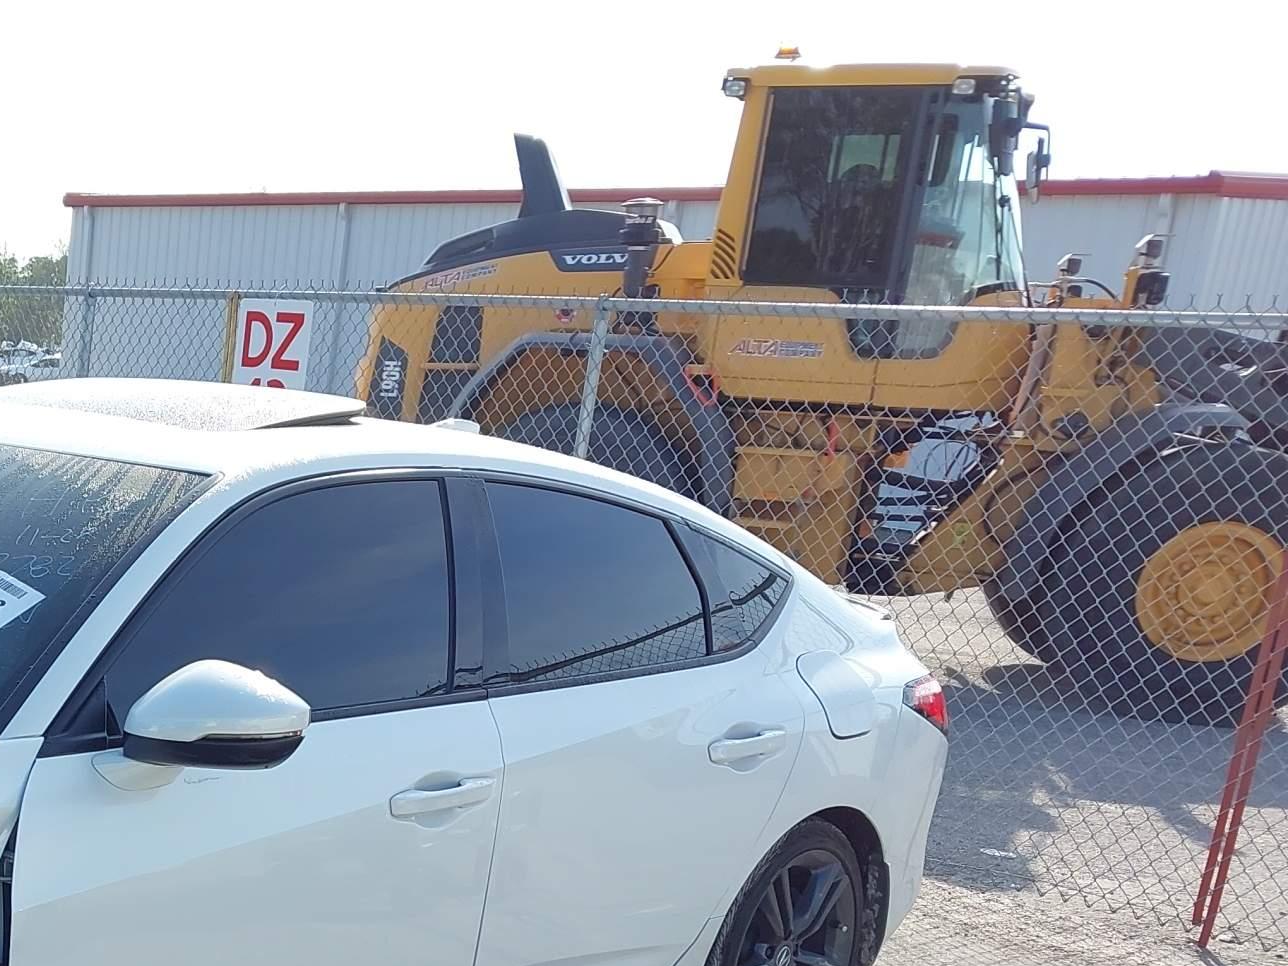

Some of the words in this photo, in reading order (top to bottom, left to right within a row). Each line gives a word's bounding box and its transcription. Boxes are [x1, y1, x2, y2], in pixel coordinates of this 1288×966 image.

[562, 253, 629, 265] VOLV
[240, 311, 305, 371] DZ
[728, 339, 777, 357] ALTA
[379, 360, 402, 398] L90H
